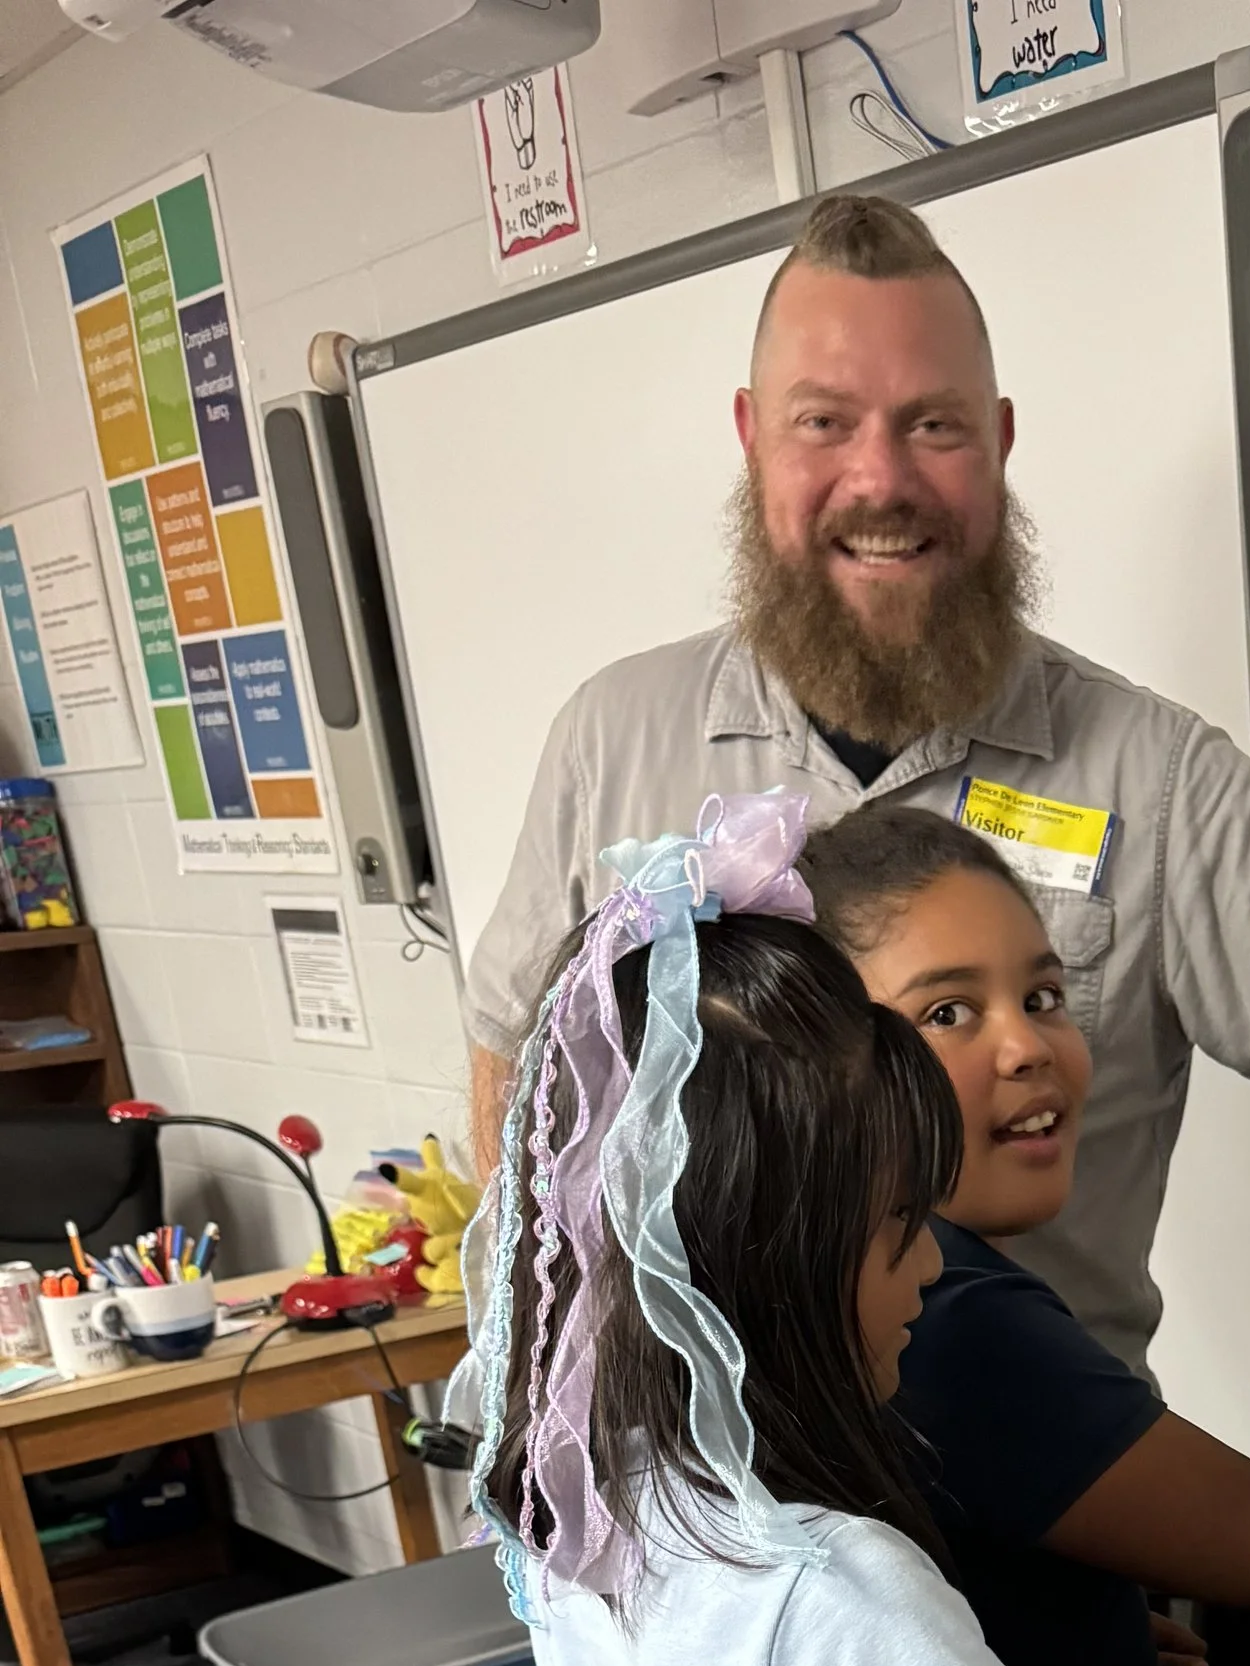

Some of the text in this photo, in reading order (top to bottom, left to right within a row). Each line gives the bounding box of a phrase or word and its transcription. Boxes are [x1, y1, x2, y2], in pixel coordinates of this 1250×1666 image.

[1012, 25, 1058, 68] water
[505, 183, 512, 203] I
[515, 175, 531, 198] need
[545, 169, 559, 188] use
[519, 199, 568, 230] restroom
[966, 809, 1025, 841] Visitor
